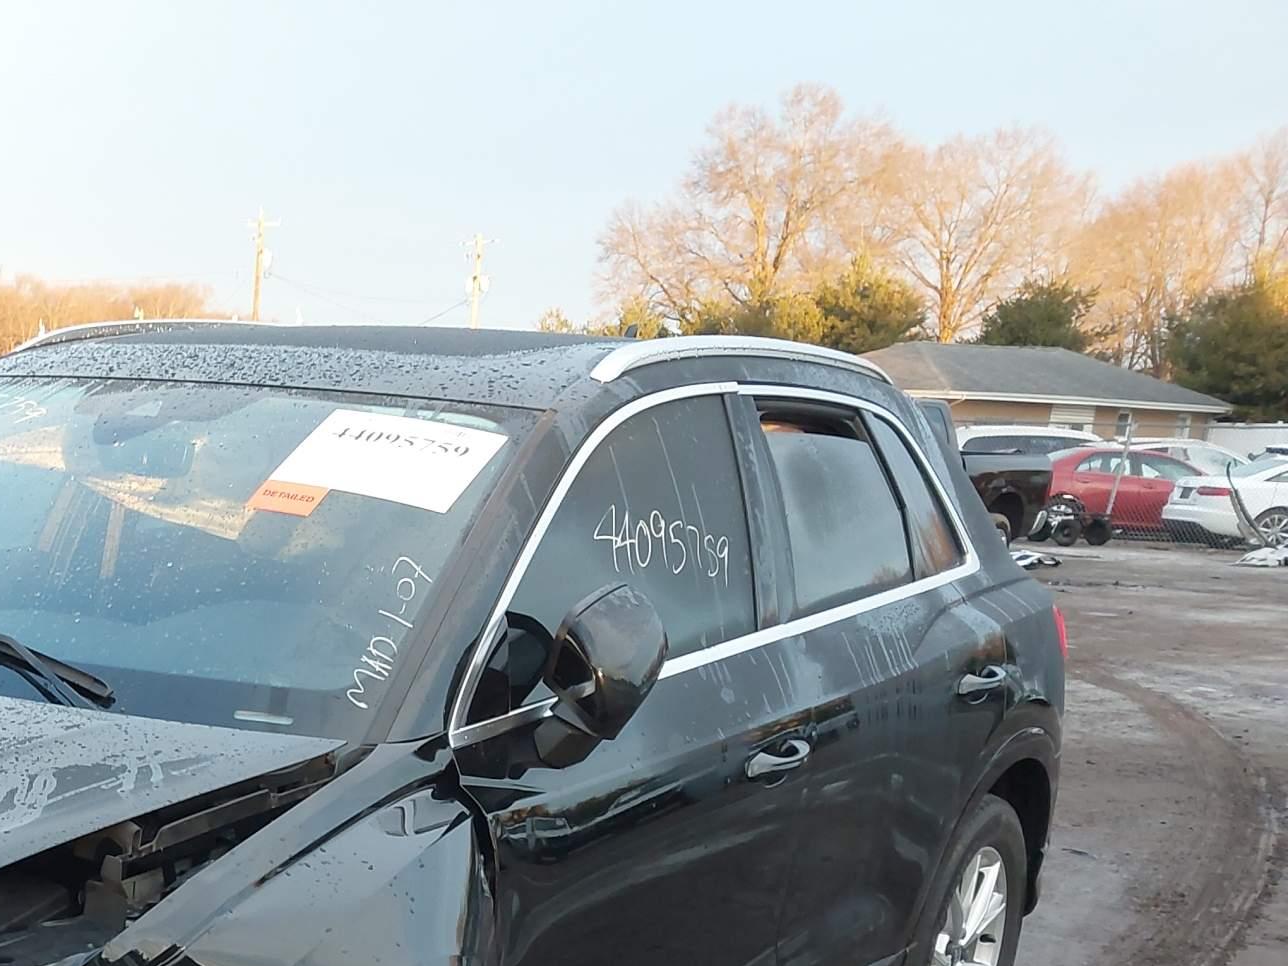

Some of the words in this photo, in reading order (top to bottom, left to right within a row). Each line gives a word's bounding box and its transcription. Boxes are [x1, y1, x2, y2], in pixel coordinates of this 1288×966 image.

[332, 426, 470, 457] 44095759
[262, 488, 316, 504] DETAILED
[593, 503, 730, 589] 44095759
[346, 635, 399, 710] MAD
[378, 556, 434, 629] 1-07
